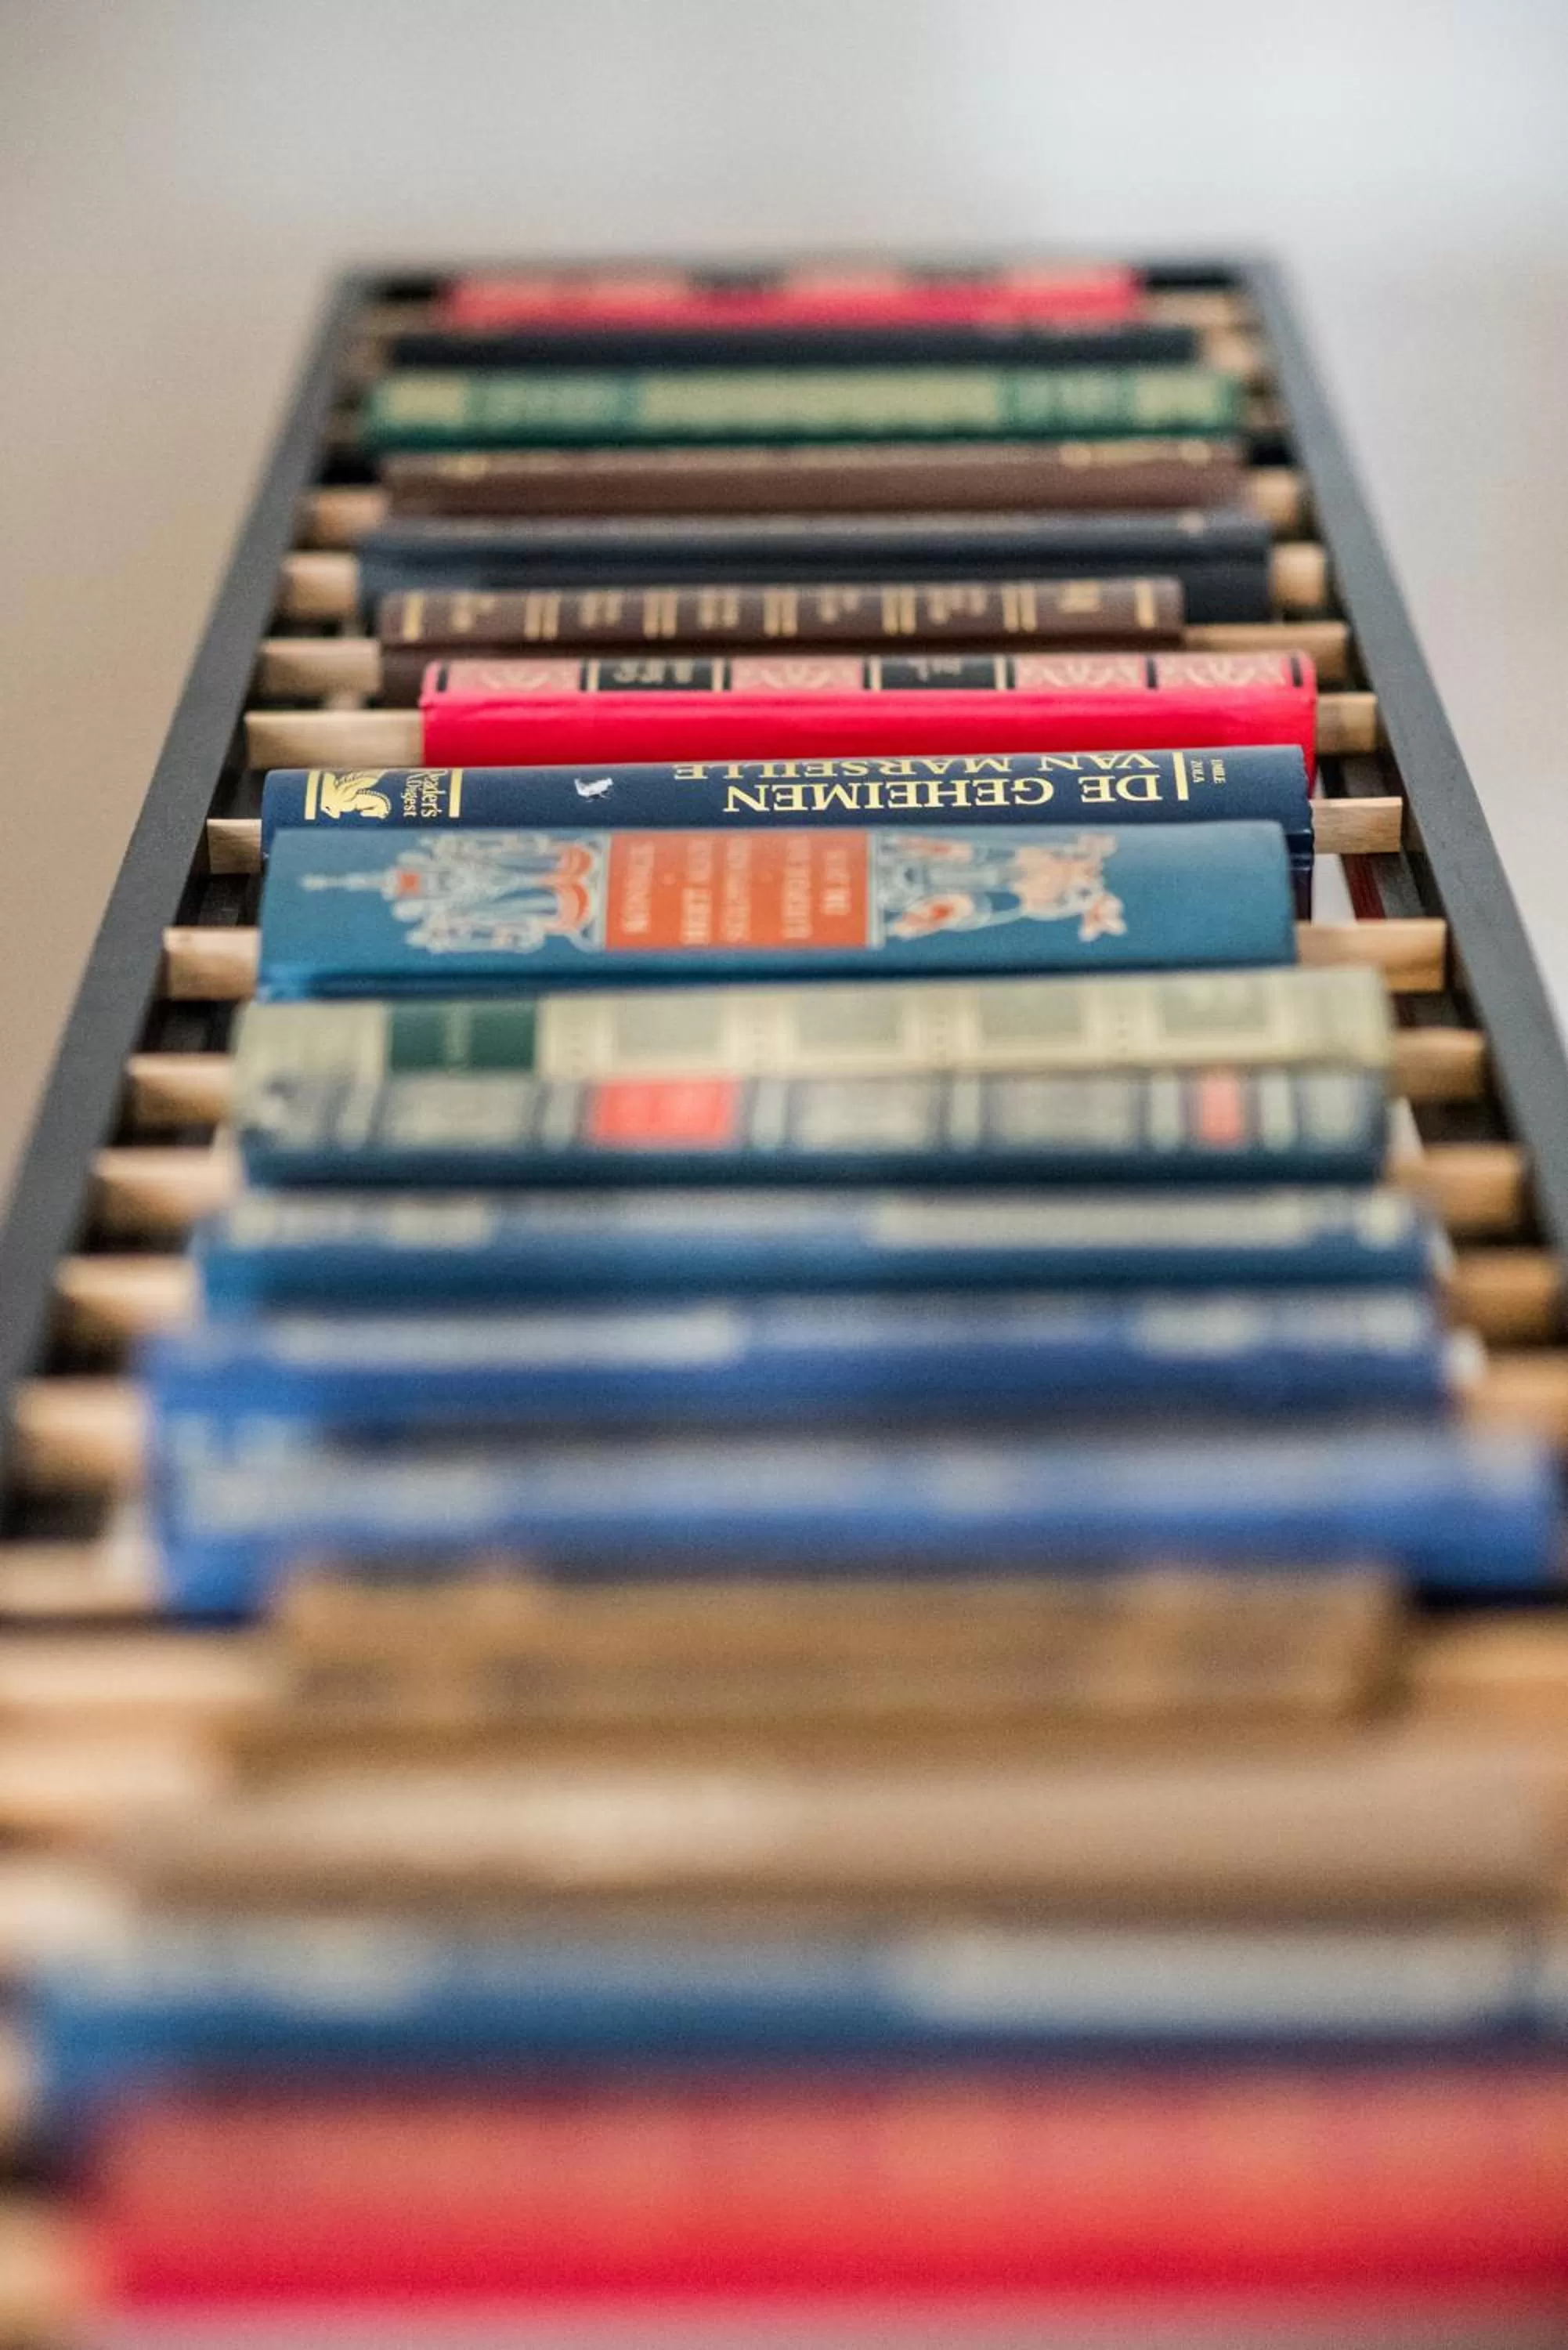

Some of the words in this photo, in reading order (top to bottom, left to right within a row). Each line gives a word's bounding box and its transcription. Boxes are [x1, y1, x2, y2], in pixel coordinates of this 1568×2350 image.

[674, 757, 1013, 780] MARSEILLE
[1036, 753, 1161, 772] VAN
[723, 777, 1054, 812] GEHEIMEN
[1078, 775, 1163, 803] DE
